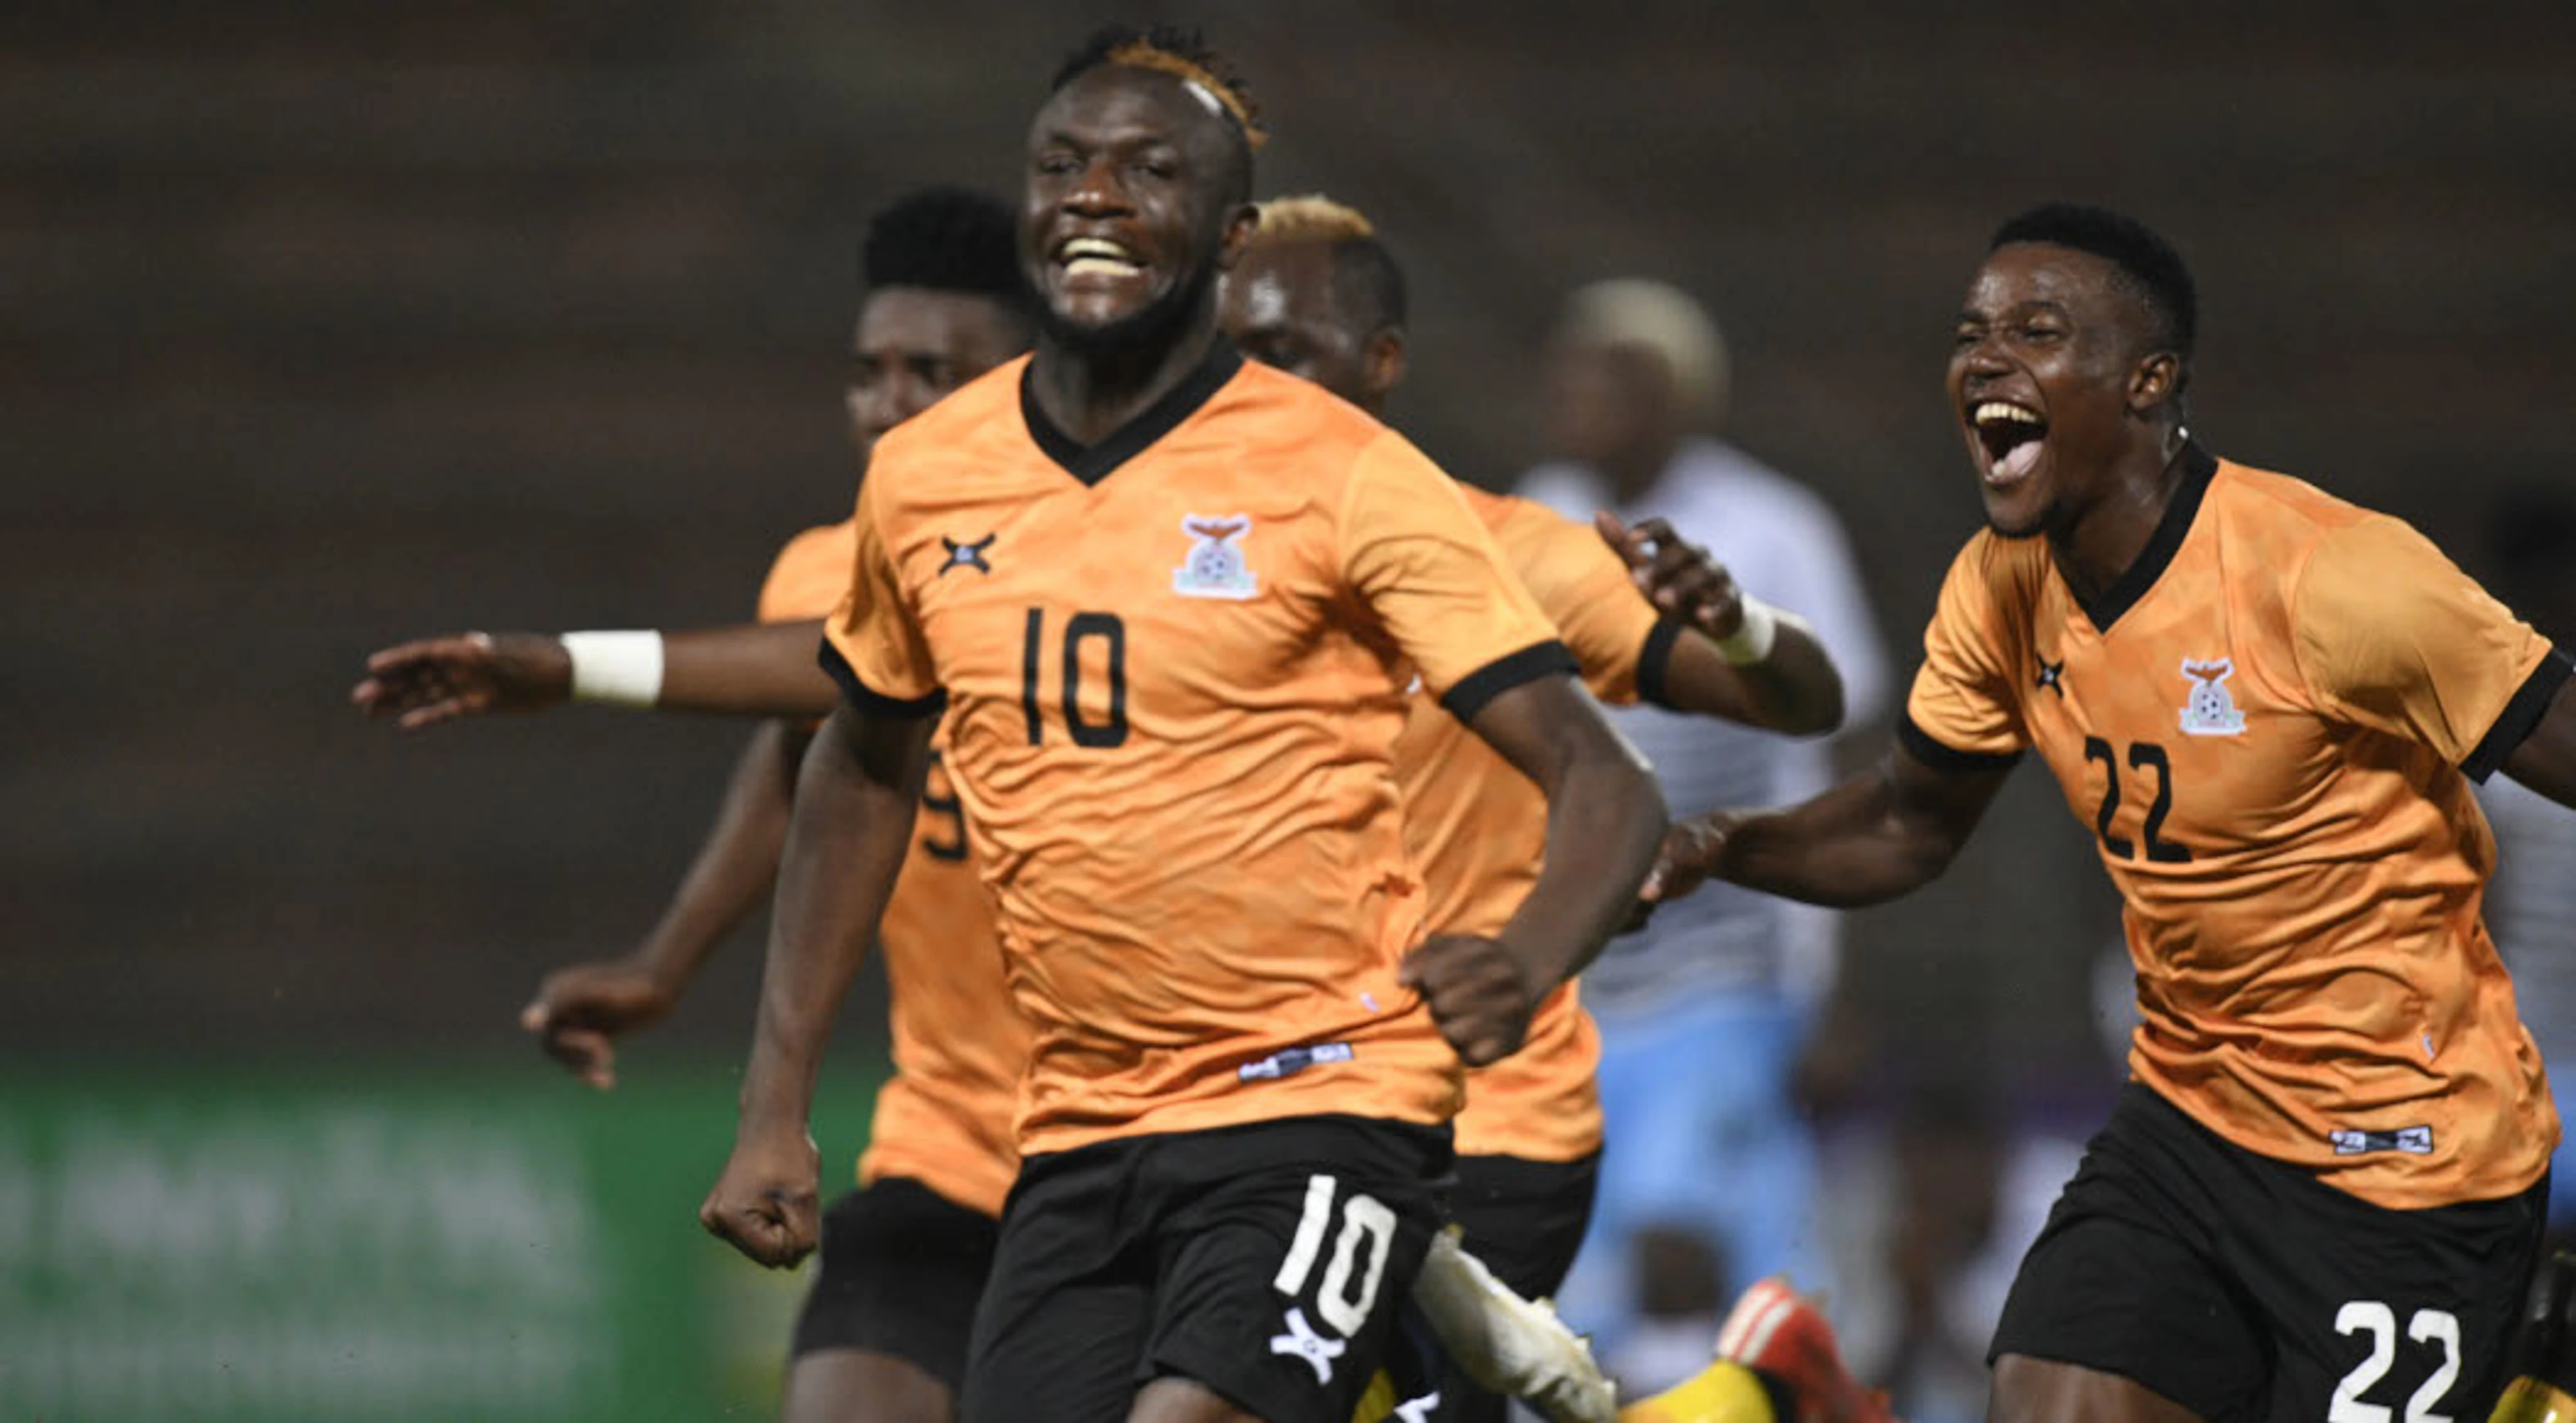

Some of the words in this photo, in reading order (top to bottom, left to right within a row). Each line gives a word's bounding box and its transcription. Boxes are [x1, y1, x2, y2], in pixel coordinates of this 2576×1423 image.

[1023, 607, 1128, 748] 10
[2084, 734, 2193, 863] 22
[1274, 1174, 1397, 1337] 10
[2327, 1301, 2461, 1423] 22
